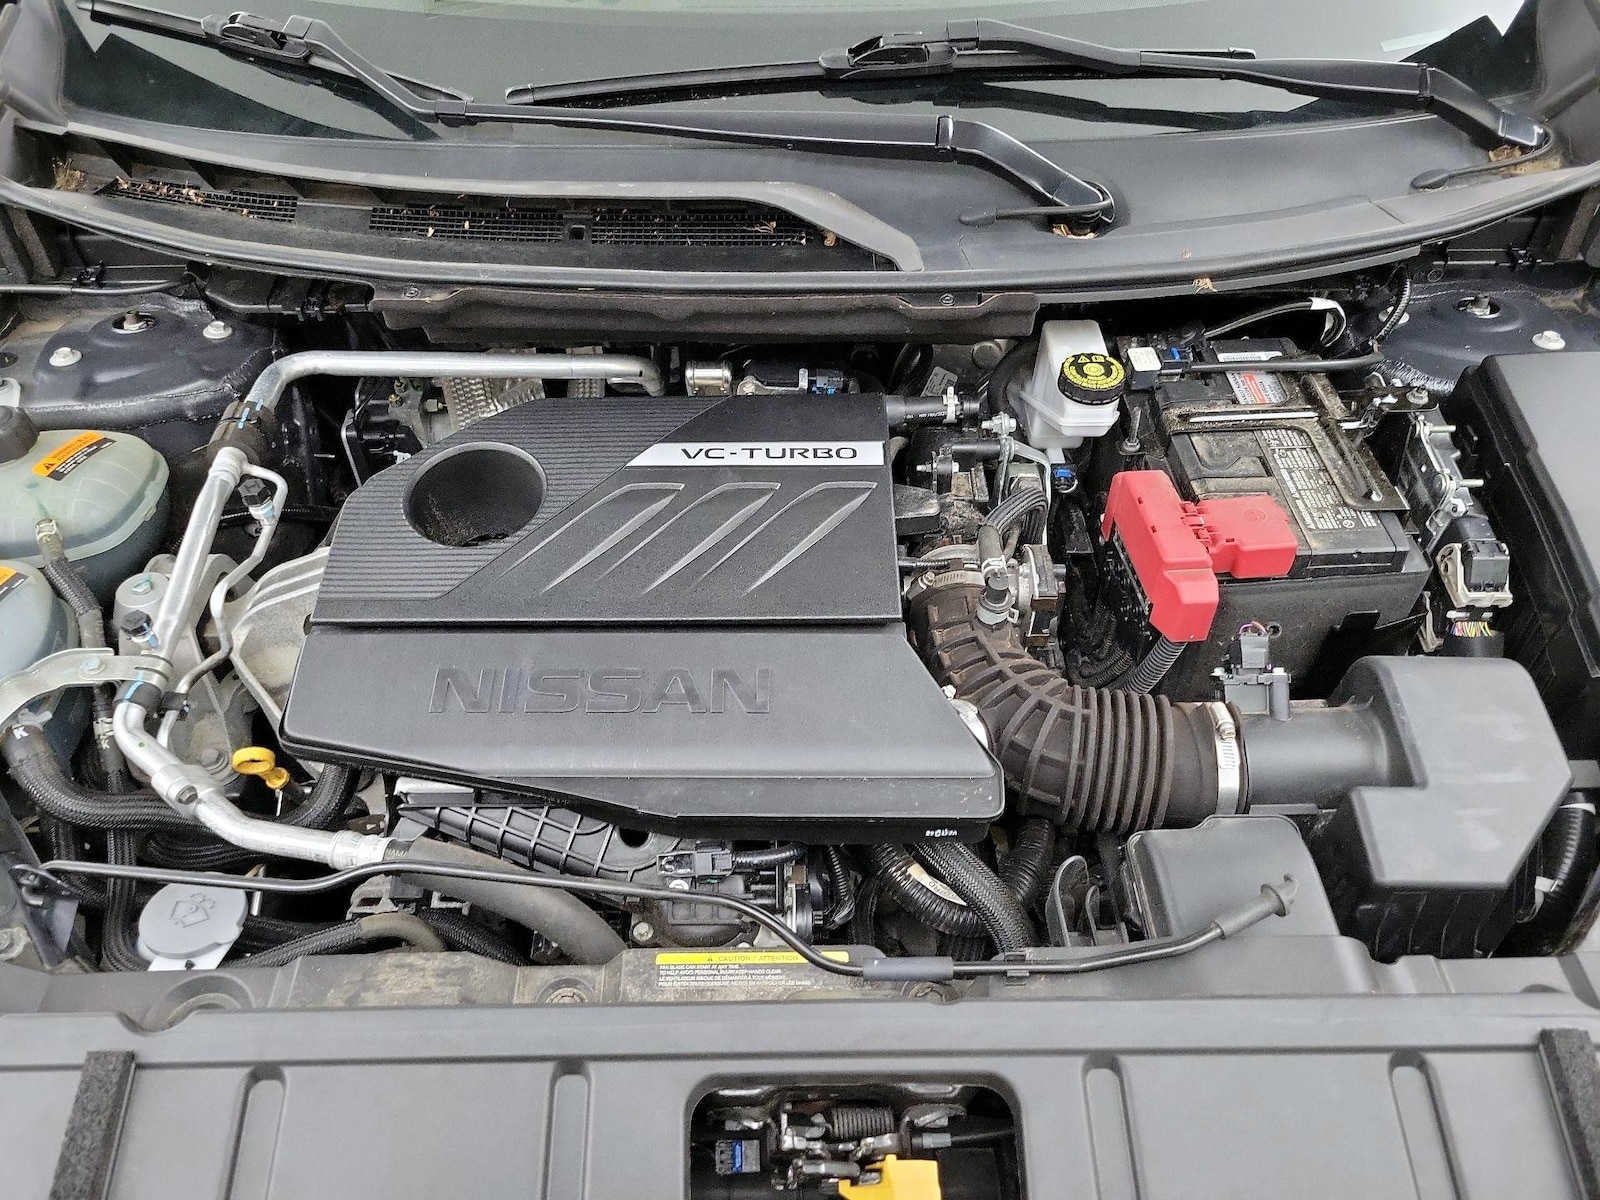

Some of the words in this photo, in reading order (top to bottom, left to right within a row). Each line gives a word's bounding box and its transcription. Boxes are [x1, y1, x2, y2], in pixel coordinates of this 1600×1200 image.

[681, 447, 858, 460] VC-TURBO
[429, 667, 770, 714] NISSAN
[12, 726, 29, 740] K
